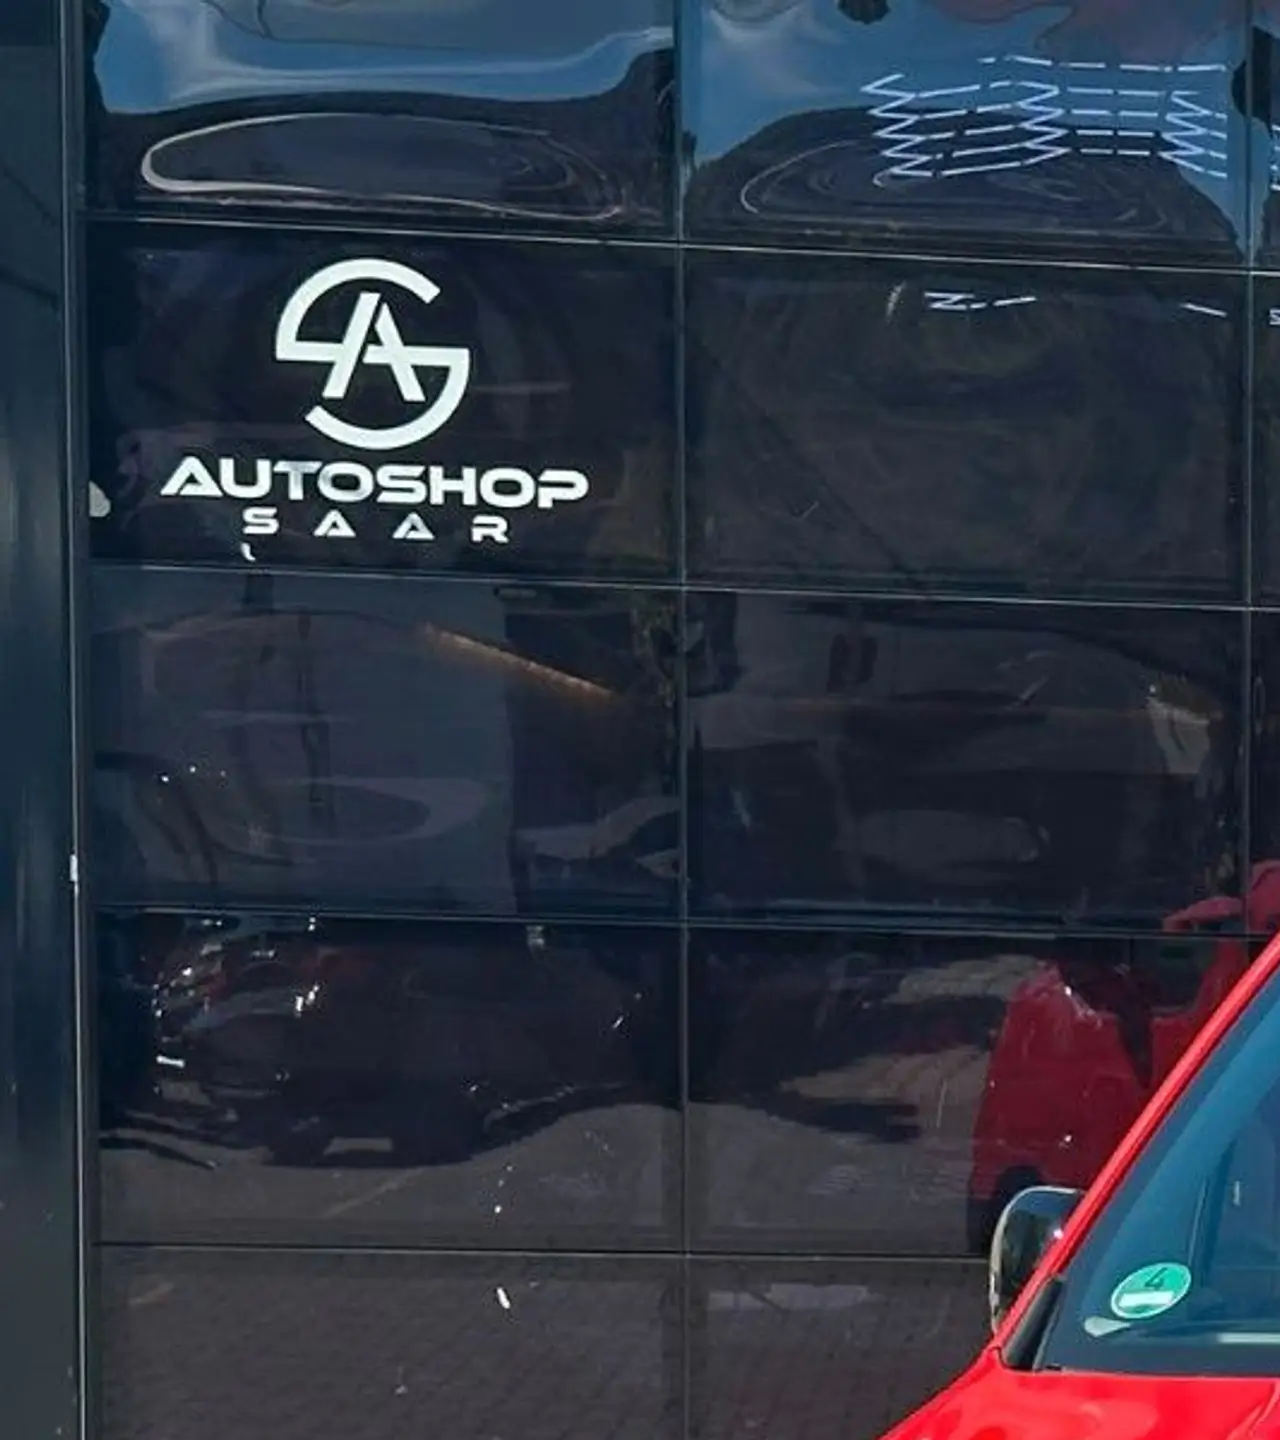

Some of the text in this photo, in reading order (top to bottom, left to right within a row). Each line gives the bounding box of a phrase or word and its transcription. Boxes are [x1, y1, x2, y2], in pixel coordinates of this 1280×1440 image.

[160, 455, 590, 509] AUTOSHOP
[241, 506, 511, 544] SAAR
[1144, 1266, 1167, 1289] 4
